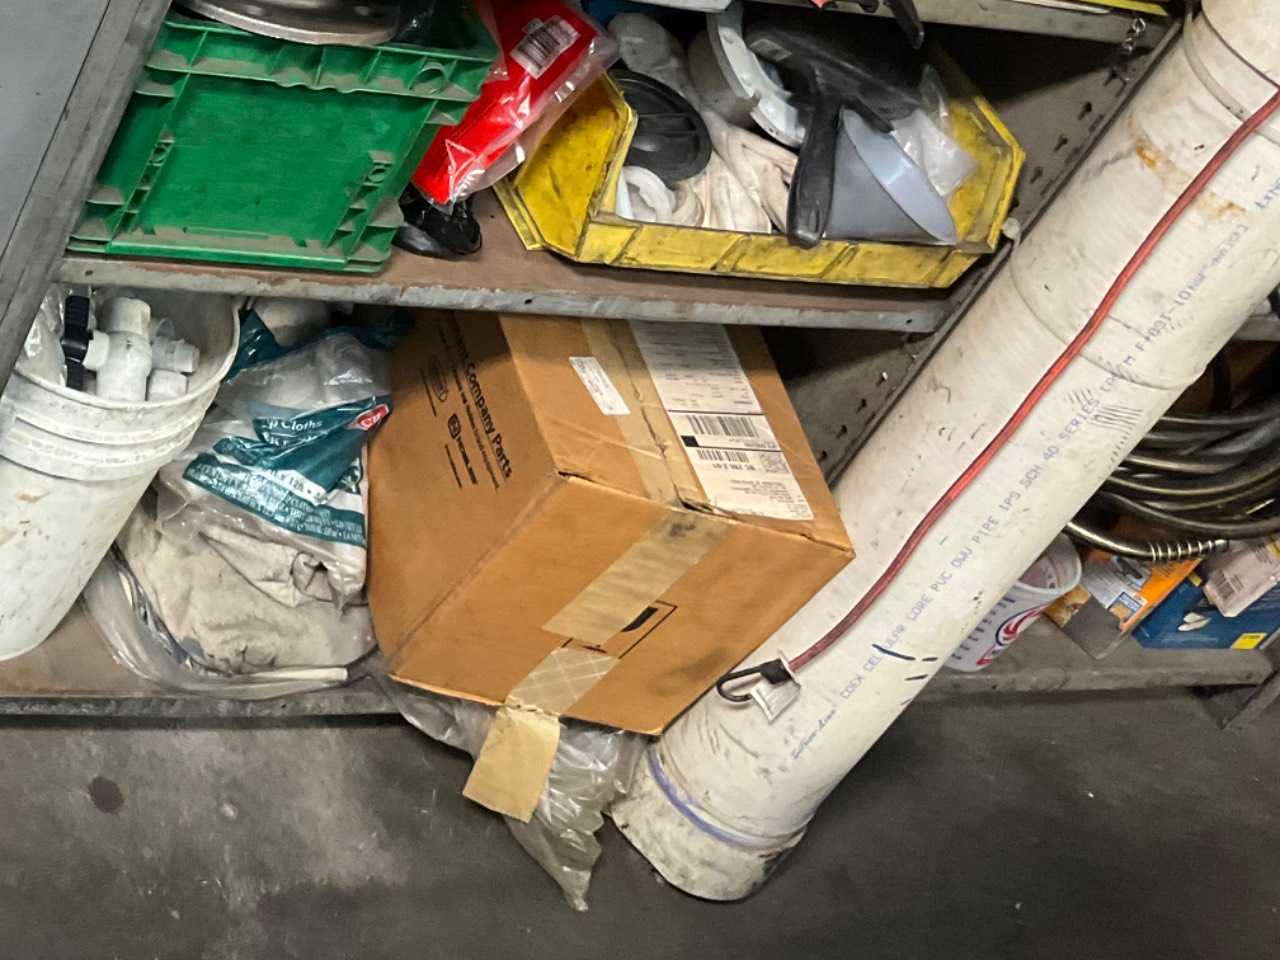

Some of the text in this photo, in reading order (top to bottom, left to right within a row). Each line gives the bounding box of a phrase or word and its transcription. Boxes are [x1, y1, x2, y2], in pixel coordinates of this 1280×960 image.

[281, 418, 323, 432] Cloths
[465, 361, 496, 435] Company
[491, 433, 512, 479] Parts
[972, 515, 999, 543] PIPE
[1019, 464, 1042, 489] SCH
[1058, 397, 1101, 440] SERIES
